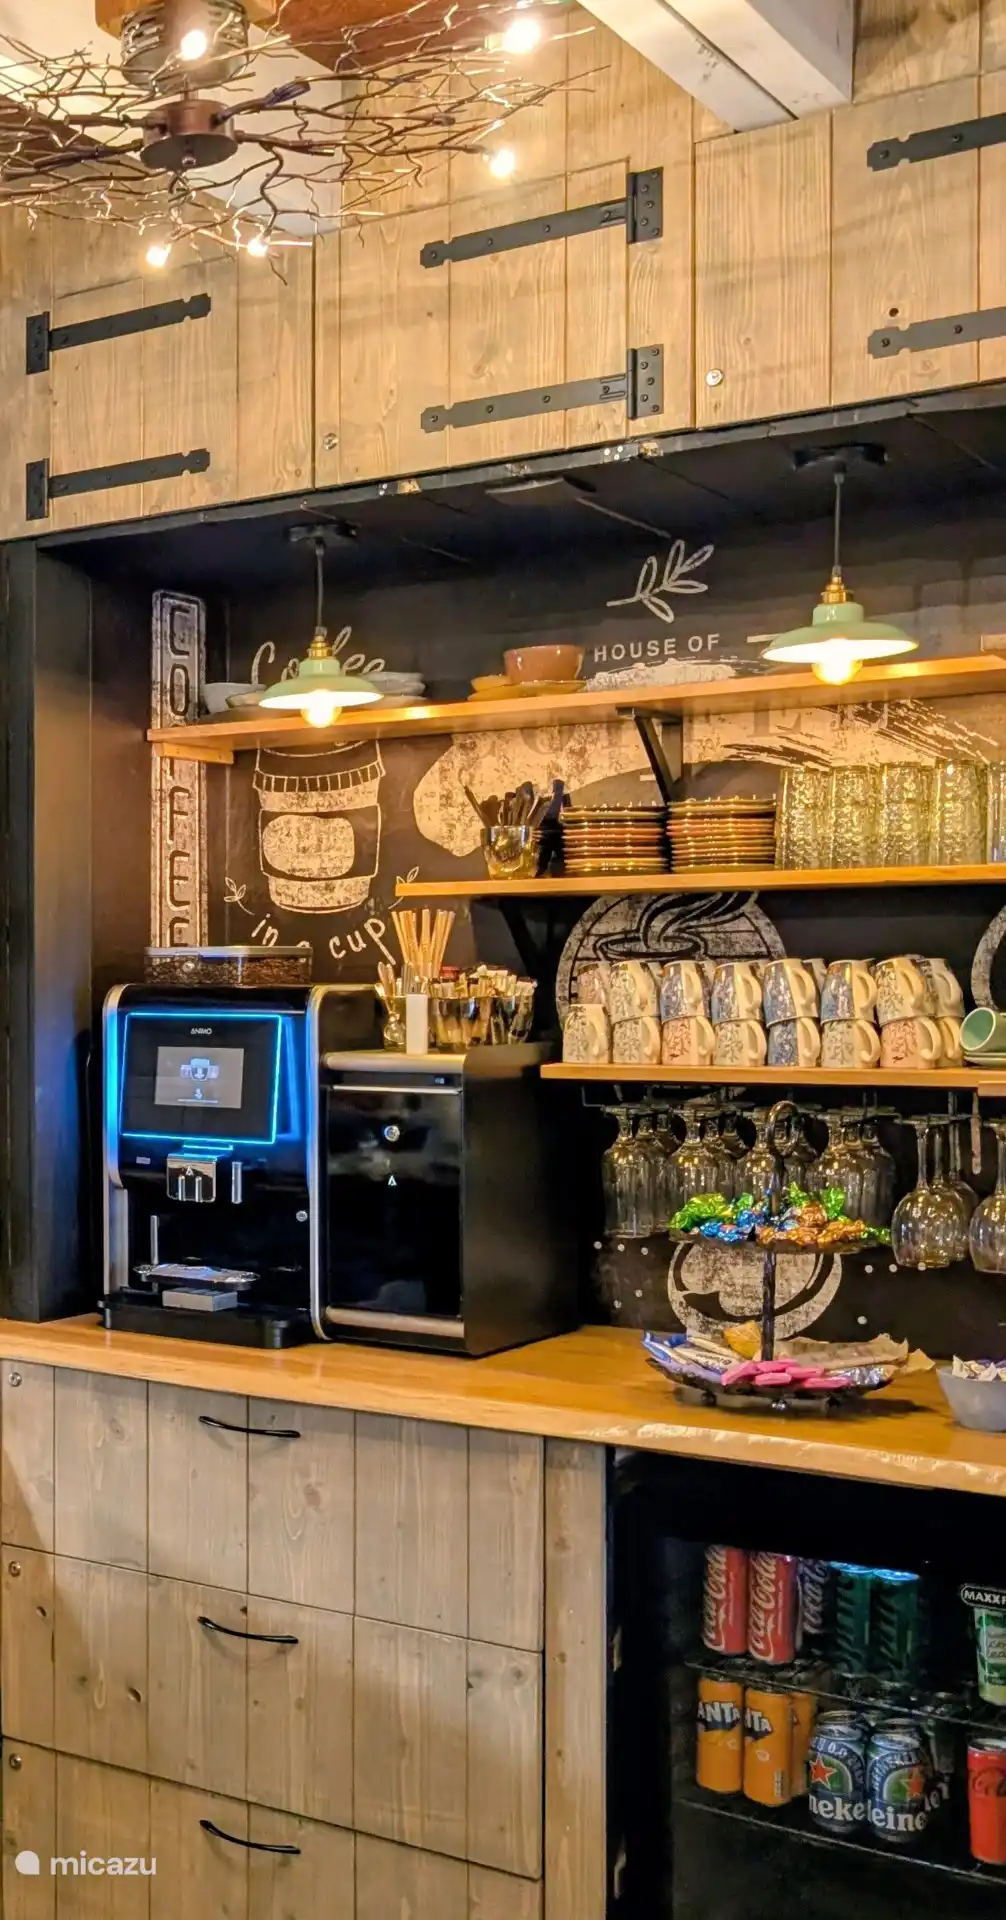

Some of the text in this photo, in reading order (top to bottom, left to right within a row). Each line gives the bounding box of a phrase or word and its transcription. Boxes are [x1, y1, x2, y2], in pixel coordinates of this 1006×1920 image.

[594, 633, 720, 662] HOUSE OF
[329, 918, 396, 965] cup
[190, 1027, 213, 1036] ANIMO
